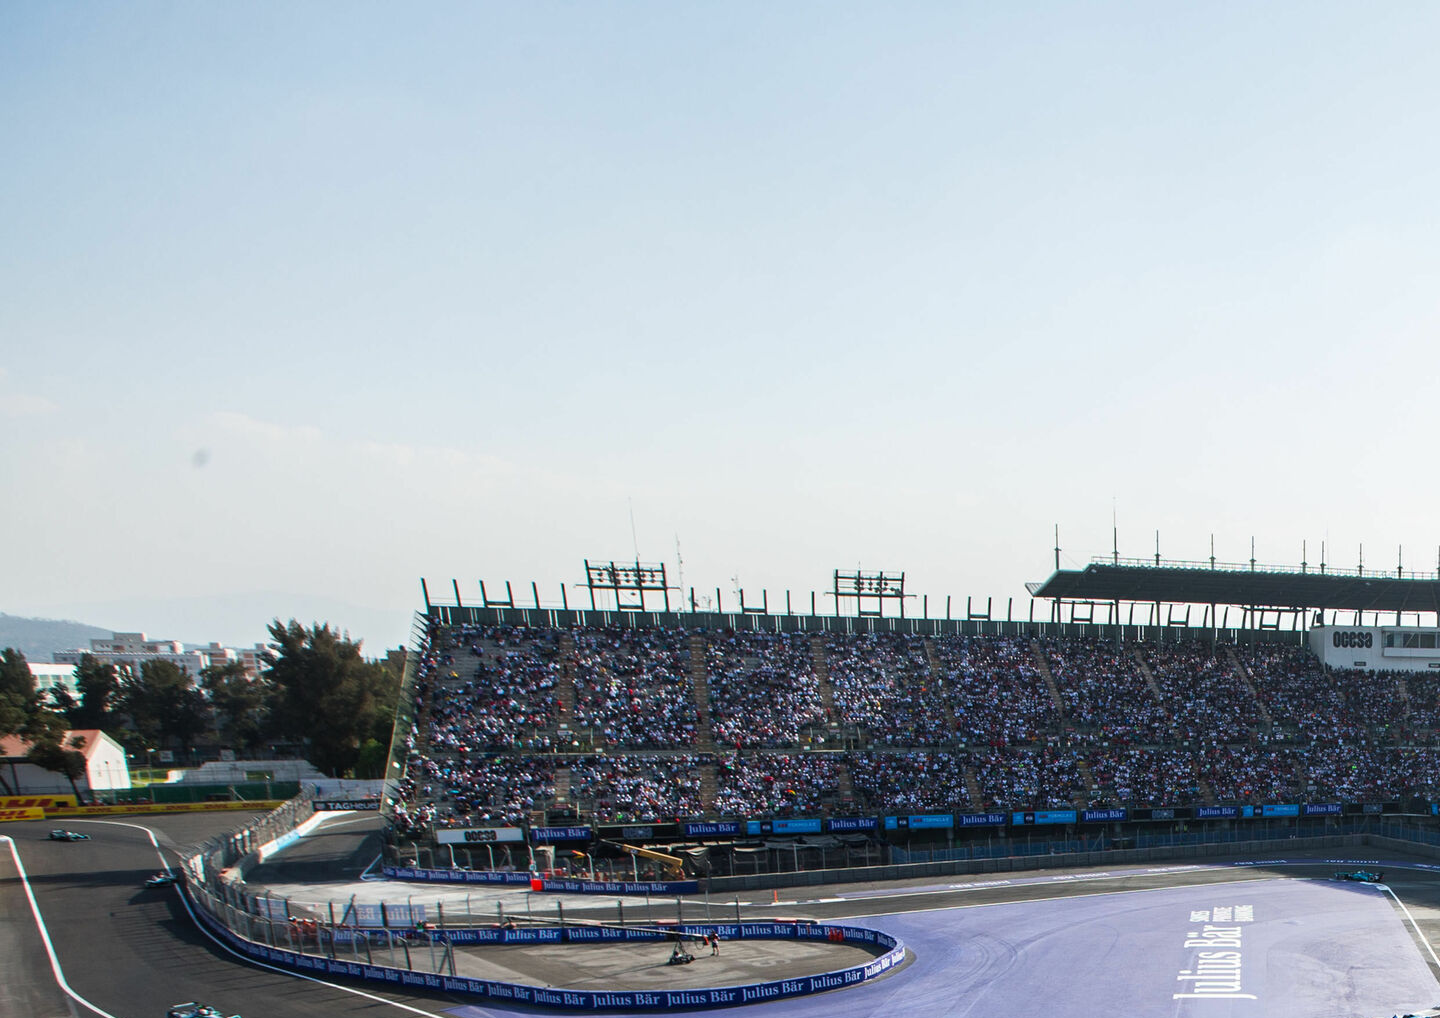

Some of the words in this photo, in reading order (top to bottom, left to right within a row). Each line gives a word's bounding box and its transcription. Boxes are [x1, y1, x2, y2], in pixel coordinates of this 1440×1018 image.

[535, 829, 564, 840] Julius
[567, 828, 587, 838] Bär
[505, 930, 536, 942] Julius
[538, 929, 559, 940] Bär
[568, 928, 599, 940] Julius
[601, 927, 621, 938] Bär
[718, 926, 737, 936] Bär
[741, 926, 769, 937] Julius
[771, 925, 791, 935] Bär
[1184, 924, 1242, 948] Bär
[402, 972, 423, 986] Julius
[424, 974, 440, 987] Bär
[810, 976, 843, 992] Julius
[845, 971, 861, 983] Bär
[1172, 951, 1258, 1000] Julius
[443, 978, 467, 992] Julius
[469, 981, 484, 993] Bär
[487, 984, 512, 998] Julius
[514, 986, 530, 999] Bär
[743, 985, 779, 1001] Julius
[782, 980, 803, 993] Bär
[534, 991, 561, 1004] Julius
[563, 993, 586, 1006] Bär
[592, 995, 632, 1007] Julius
[634, 993, 660, 1006] Bär
[667, 992, 706, 1006] Julius
[710, 990, 736, 1002] Bär
